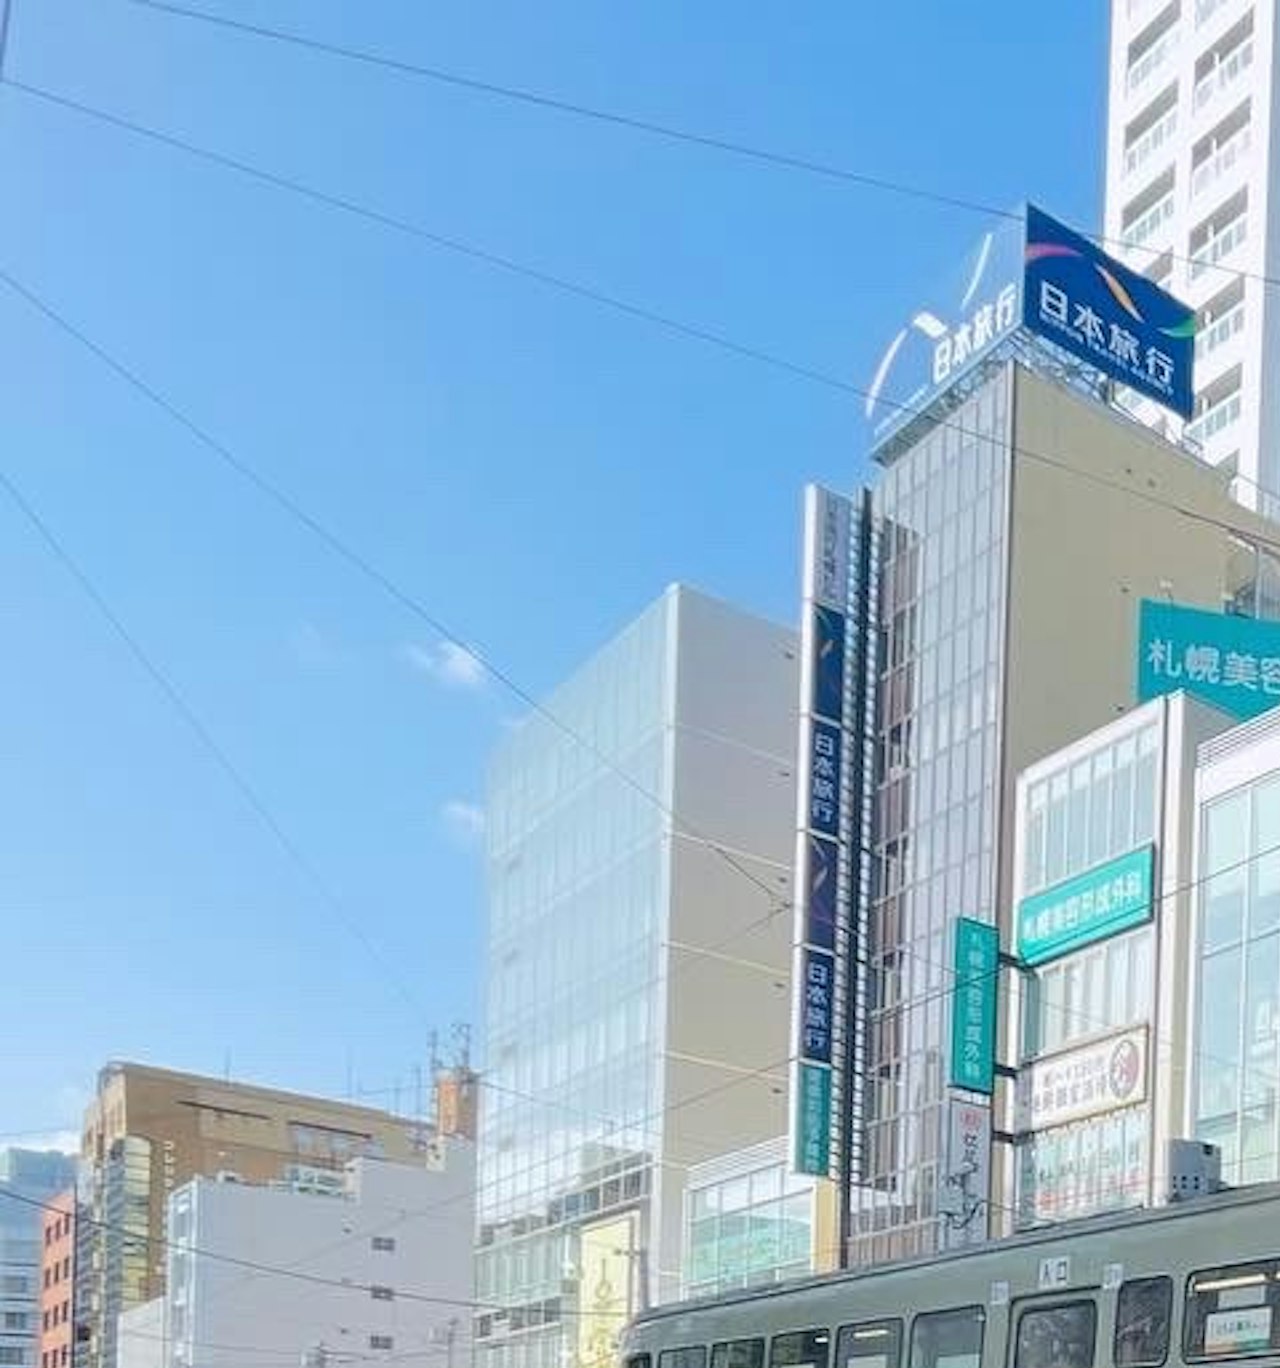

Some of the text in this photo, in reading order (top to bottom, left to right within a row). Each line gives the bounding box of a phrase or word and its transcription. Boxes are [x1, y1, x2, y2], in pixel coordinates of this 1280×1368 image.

[933, 284, 1016, 384] 日本旅行
[1039, 280, 1175, 385] 日本旅行
[812, 732, 834, 823] 日本旅行
[806, 962, 829, 1048] 日本旅行
